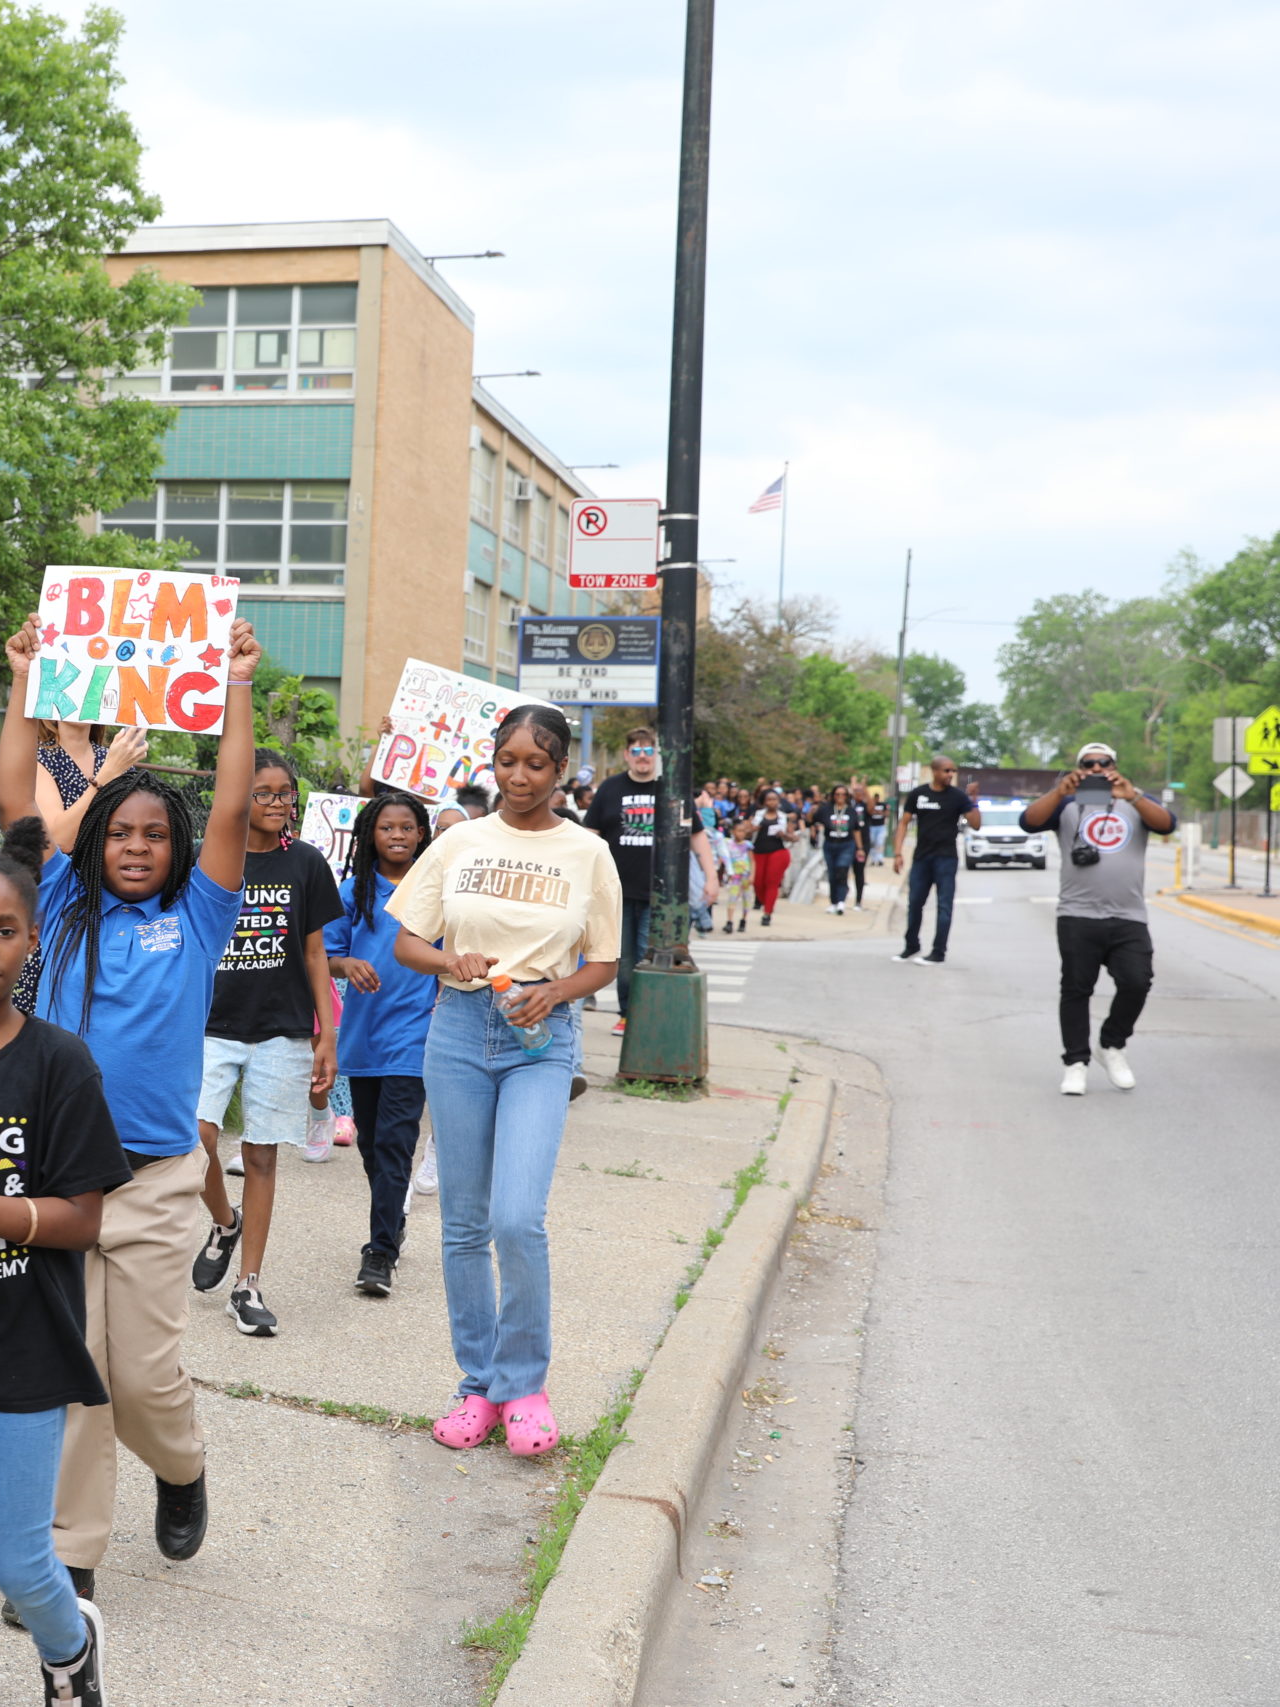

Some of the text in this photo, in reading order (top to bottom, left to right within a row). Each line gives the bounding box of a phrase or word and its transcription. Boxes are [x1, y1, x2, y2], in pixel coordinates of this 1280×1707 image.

[579, 575, 647, 587] TOW ZONE
[63, 577, 208, 643] BLM
[558, 667, 608, 677] BE KIND
[579, 678, 592, 688] TO
[33, 657, 225, 732] KING
[549, 690, 618, 700] YOUR MIND
[474, 858, 561, 877] MY BLACK IS
[456, 869, 567, 907] BEAUTIFUL
[244, 889, 291, 904] UNG
[234, 914, 288, 928] FTED &
[237, 958, 285, 970] ACADEMY
[4, 1173, 24, 1196] &
